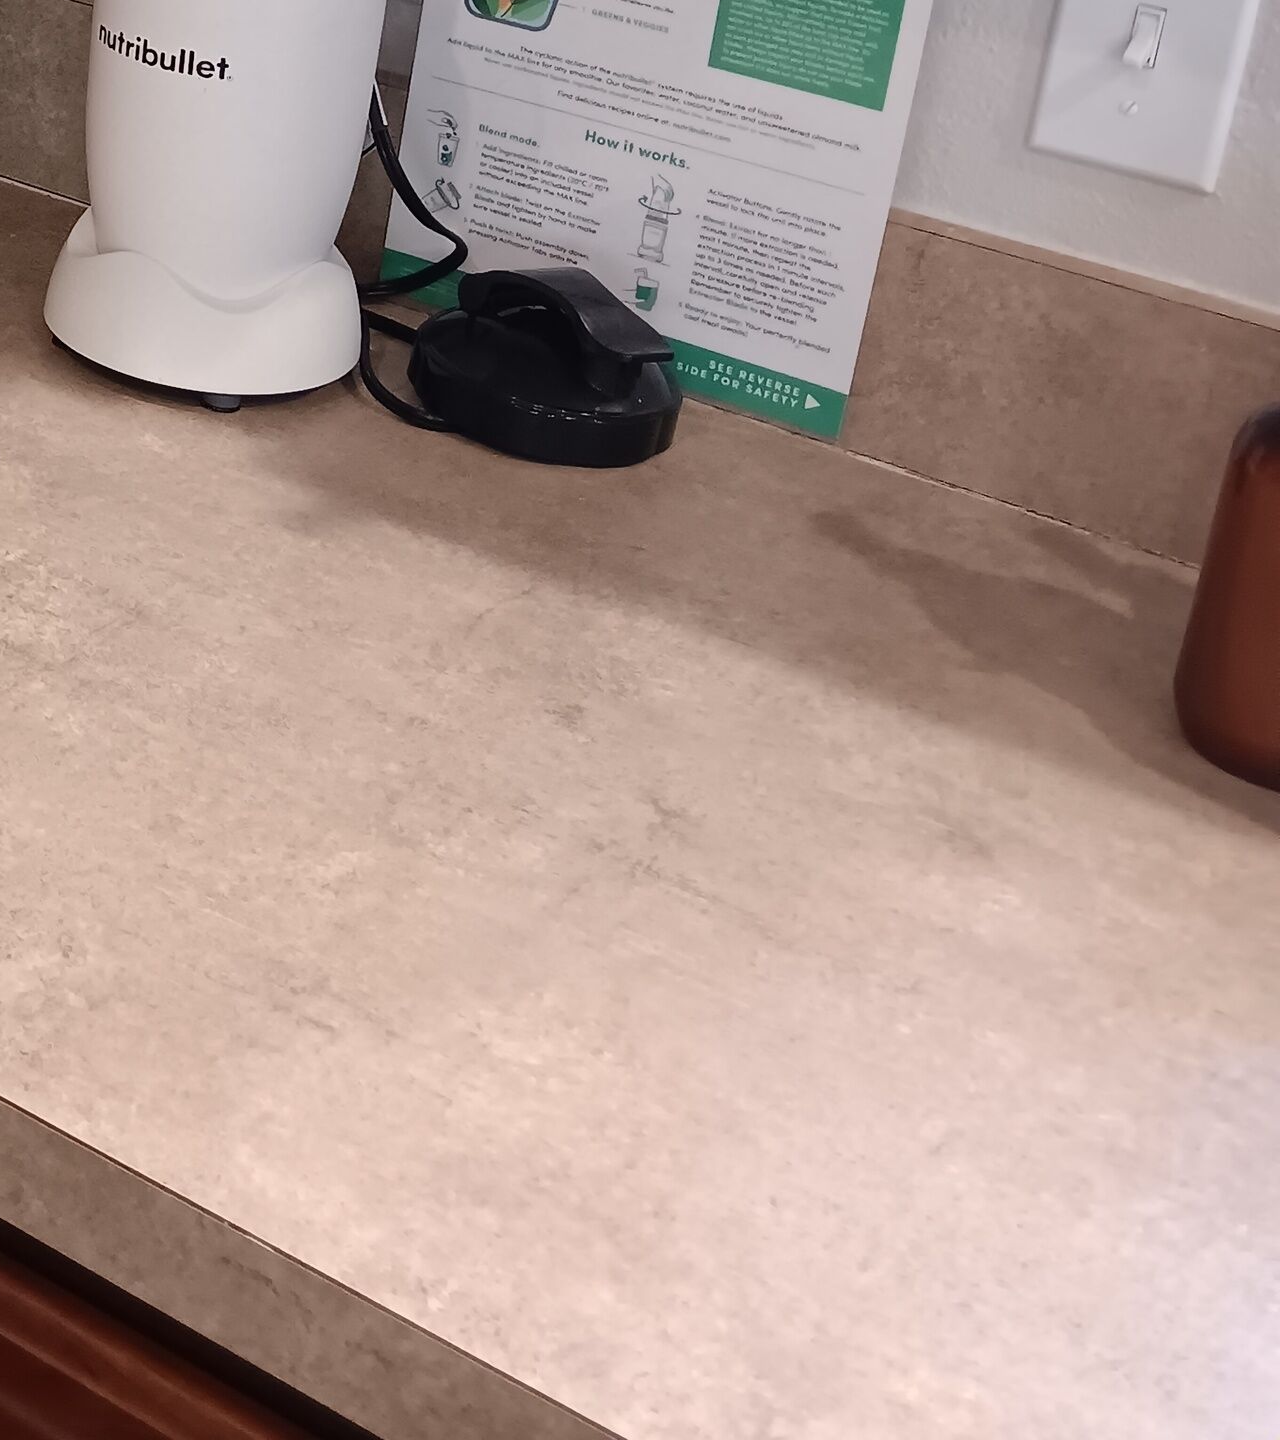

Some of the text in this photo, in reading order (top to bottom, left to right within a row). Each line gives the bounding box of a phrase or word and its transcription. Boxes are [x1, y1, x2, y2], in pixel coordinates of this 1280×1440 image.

[520, 46, 533, 54] The
[478, 124, 542, 148] Blend mode.
[584, 128, 692, 171] How it works.
[676, 361, 799, 408] SIDE FOR SAFETY
[708, 359, 801, 397] SEE REVERSE
